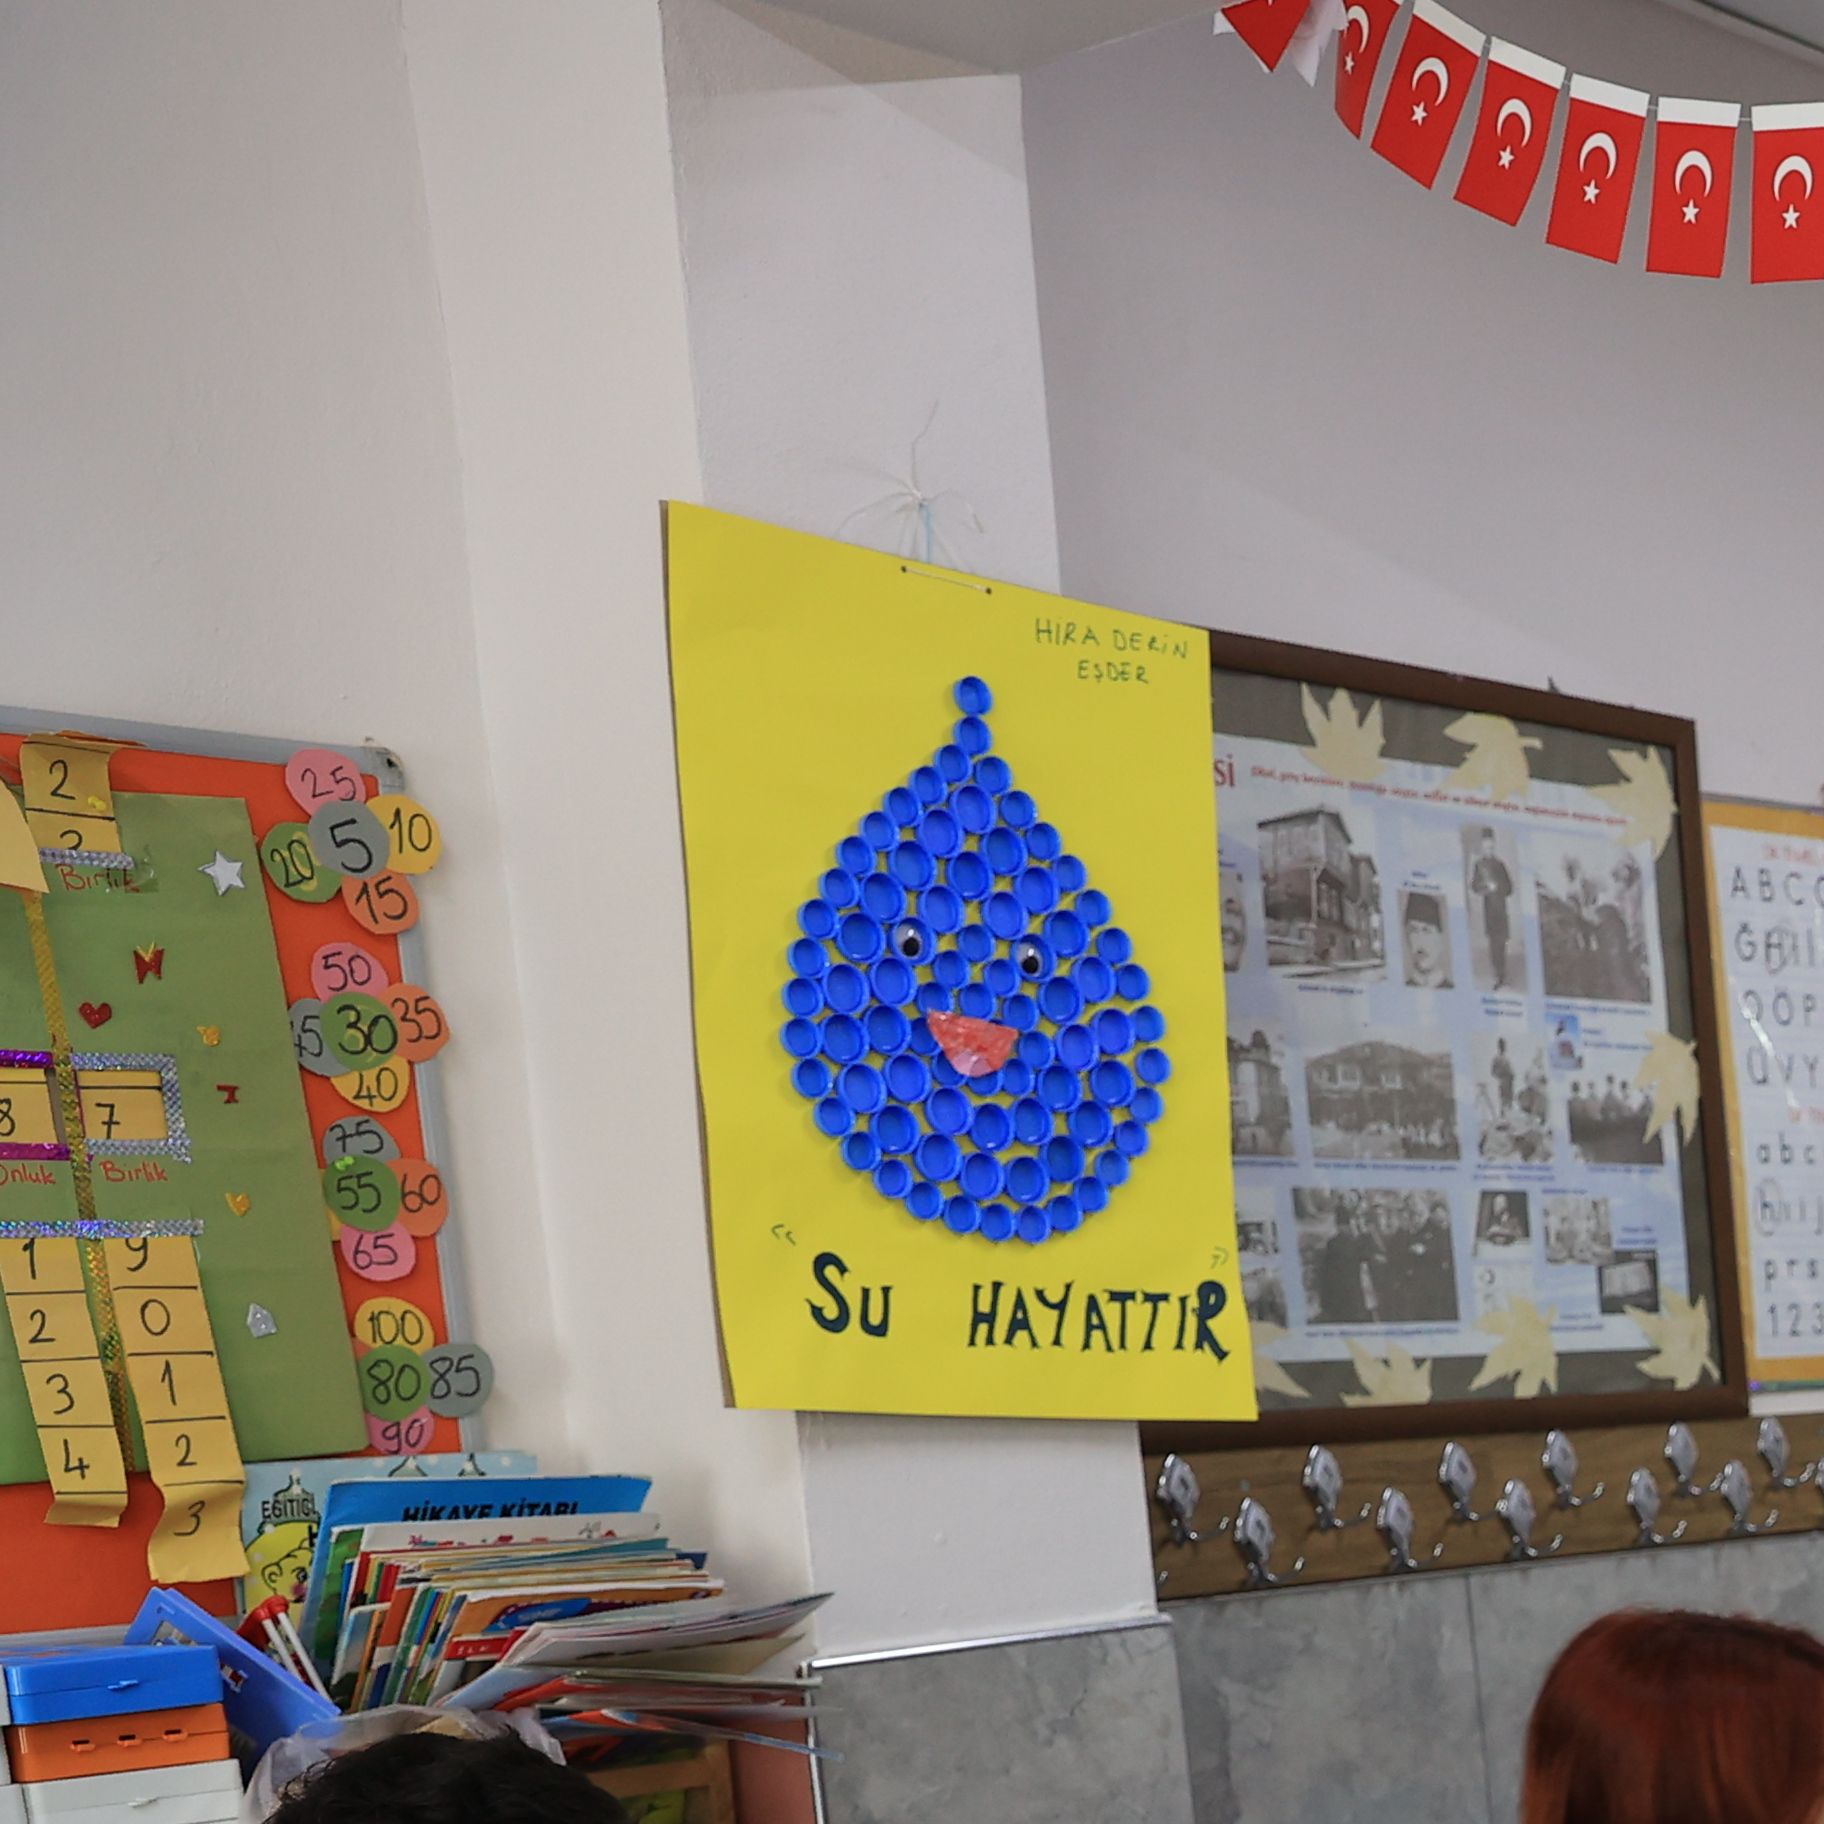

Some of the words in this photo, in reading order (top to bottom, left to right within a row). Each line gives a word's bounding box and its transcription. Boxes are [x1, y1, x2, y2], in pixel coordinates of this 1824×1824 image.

[1113, 629, 1188, 659] DERİN
[1077, 659, 1149, 684] EŞDER
[49, 759, 76, 801] 2
[300, 766, 358, 801] 25
[329, 818, 375, 875] 5
[387, 813, 433, 853] 10
[269, 838, 312, 889] 20
[354, 879, 410, 927] 15
[322, 951, 371, 992] 50
[336, 1004, 398, 1055] 30
[391, 995, 441, 1043] 35
[353, 1067, 398, 1107] 40
[95, 1103, 120, 1139] 7
[327, 1119, 386, 1155] 75
[100, 1160, 168, 1183] Birlik
[399, 1172, 444, 1210] 60
[337, 1174, 382, 1213] 55
[352, 1233, 398, 1270] 65
[28, 1307, 55, 1344] 2
[366, 1306, 426, 1348] 100
[966, 1278, 1230, 1364] HAYATTIR
[46, 1373, 75, 1415] 3
[160, 1359, 177, 1406] 1
[367, 1361, 423, 1404] 80
[430, 1352, 482, 1401] 85
[175, 1433, 198, 1467] 2
[380, 1419, 430, 1452] 90
[64, 1438, 90, 1480] 4
[173, 1500, 206, 1537] 3
